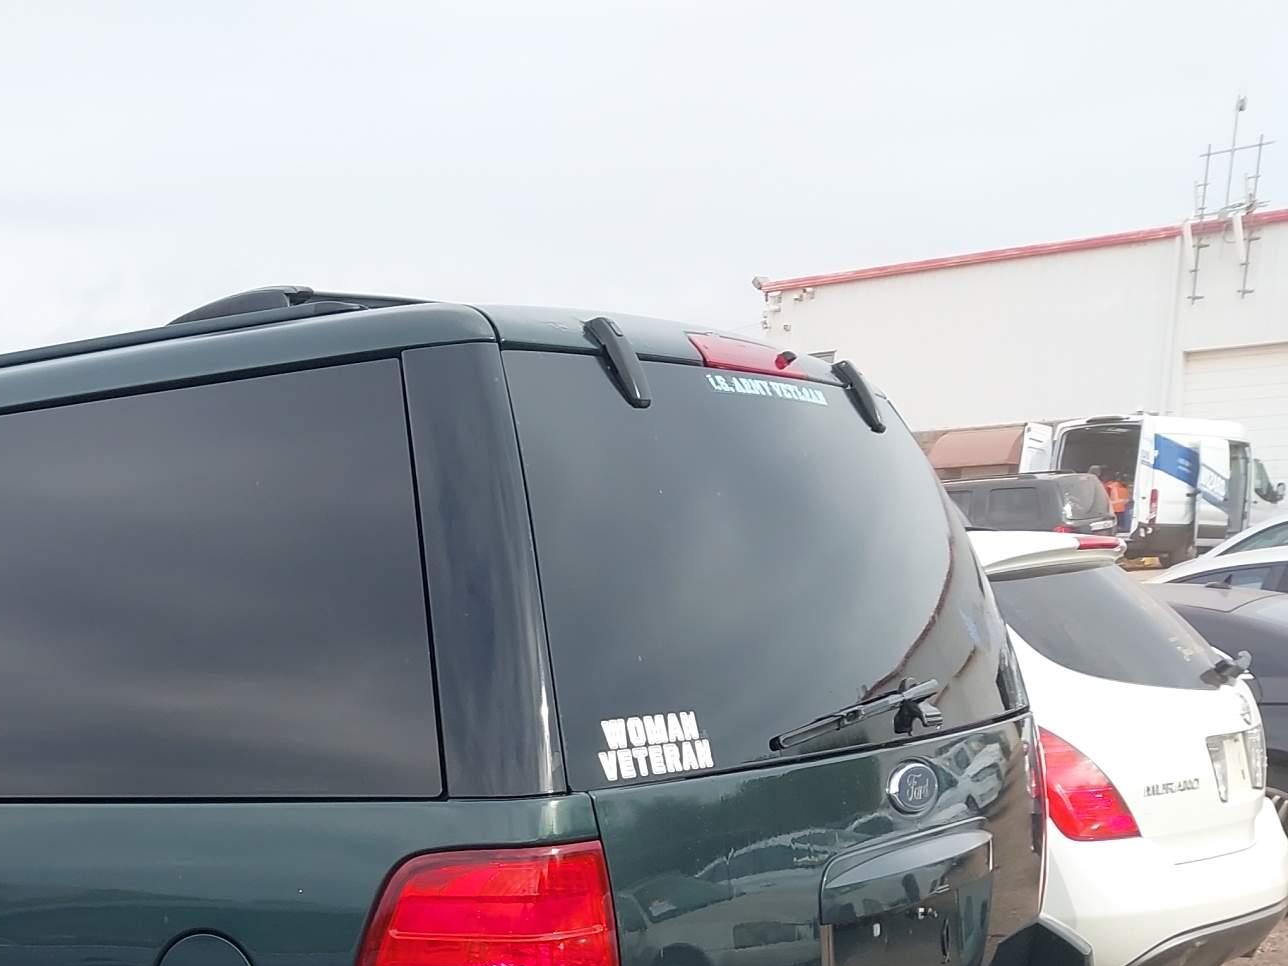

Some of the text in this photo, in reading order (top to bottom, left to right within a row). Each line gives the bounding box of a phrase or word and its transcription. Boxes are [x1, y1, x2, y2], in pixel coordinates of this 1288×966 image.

[732, 376, 773, 397] ARMY
[600, 711, 700, 750] WOMAN
[598, 738, 714, 781] VETERAN
[906, 773, 929, 801] Ford
